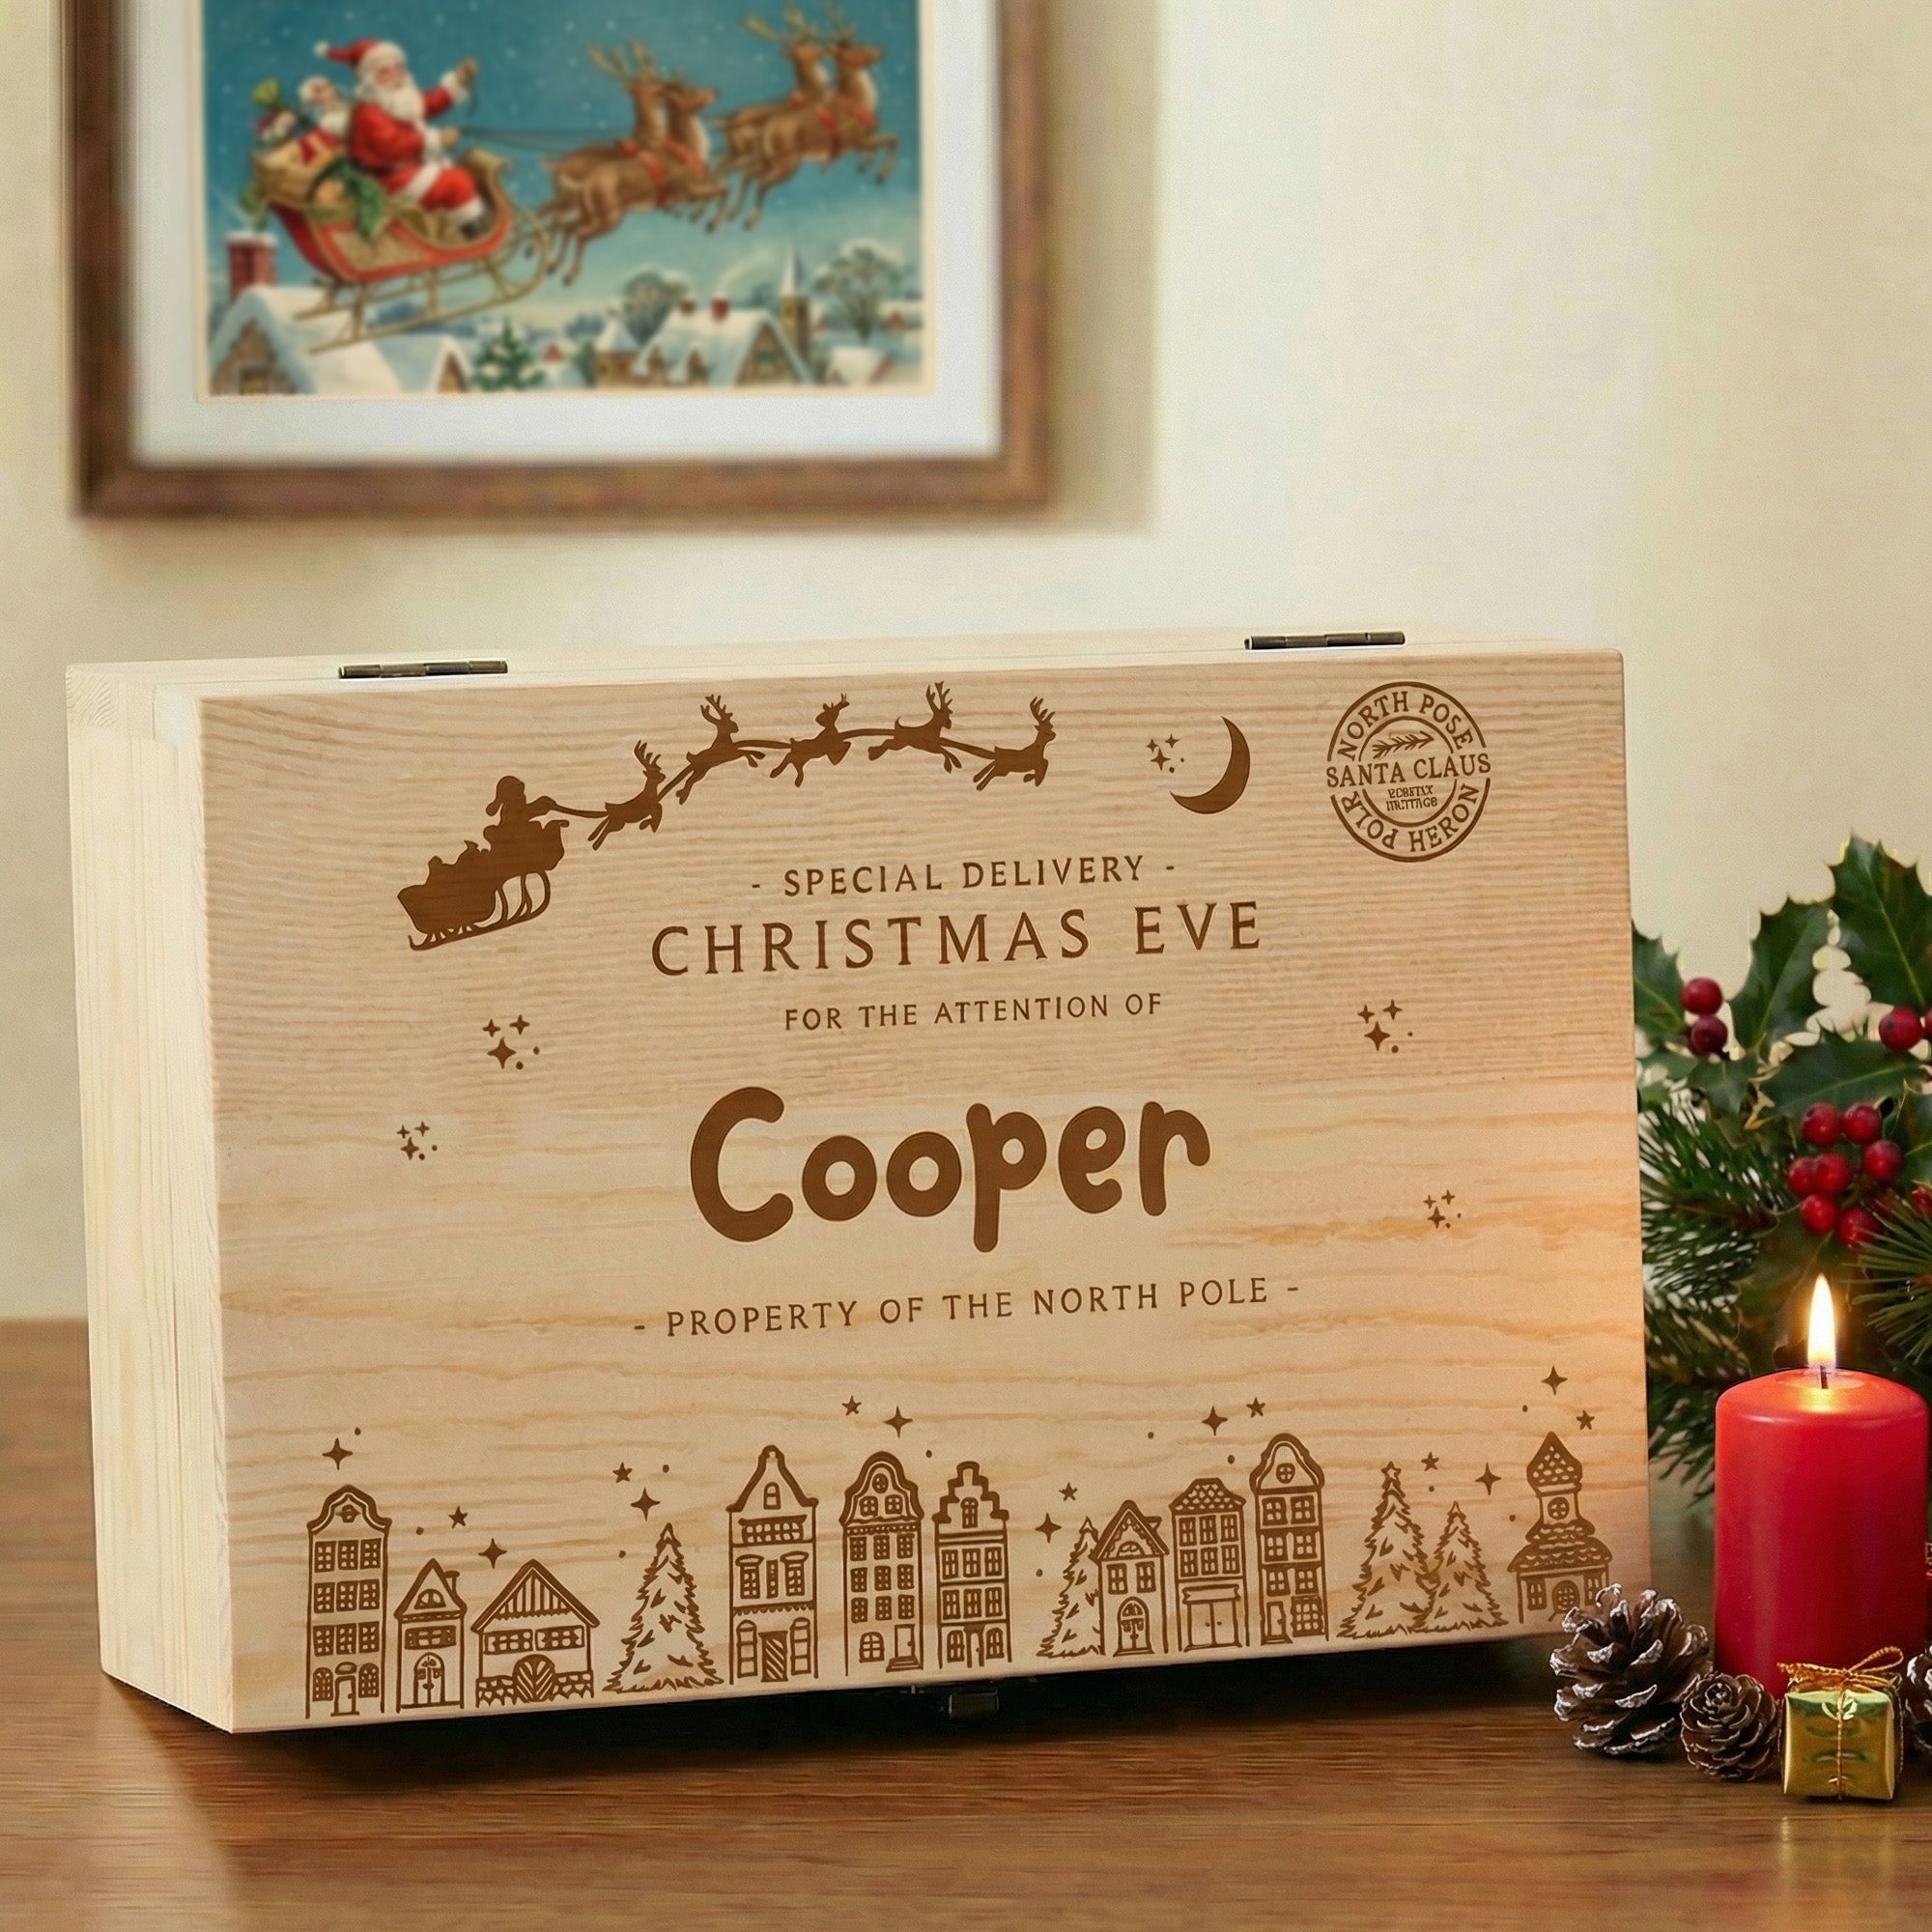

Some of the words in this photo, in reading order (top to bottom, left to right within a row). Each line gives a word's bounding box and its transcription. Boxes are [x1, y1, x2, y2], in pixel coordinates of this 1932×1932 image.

[1337, 691, 1408, 761] NORTH
[1419, 693, 1474, 750] POSE
[1325, 761, 1406, 788] SANTA
[1413, 753, 1492, 779] CLAUS
[1407, 783, 1480, 852] HERON
[783, 864, 943, 897] SPECIAL
[962, 854, 1144, 889] DELIVERY
[651, 908, 1089, 977] CHRISTMAS
[1134, 900, 1261, 955] EVE
[784, 1007, 843, 1032] FOR
[858, 1004, 918, 1029] THE
[933, 994, 1108, 1024] ATTENTION
[1124, 992, 1161, 1016] OF
[690, 1086, 1211, 1254] Cooper
[667, 1300, 858, 1338] PROPERTY
[879, 1296, 924, 1324] OF
[941, 1292, 1013, 1321] THE
[1034, 1283, 1158, 1316] NORTH
[1179, 1276, 1267, 1308] POLE
